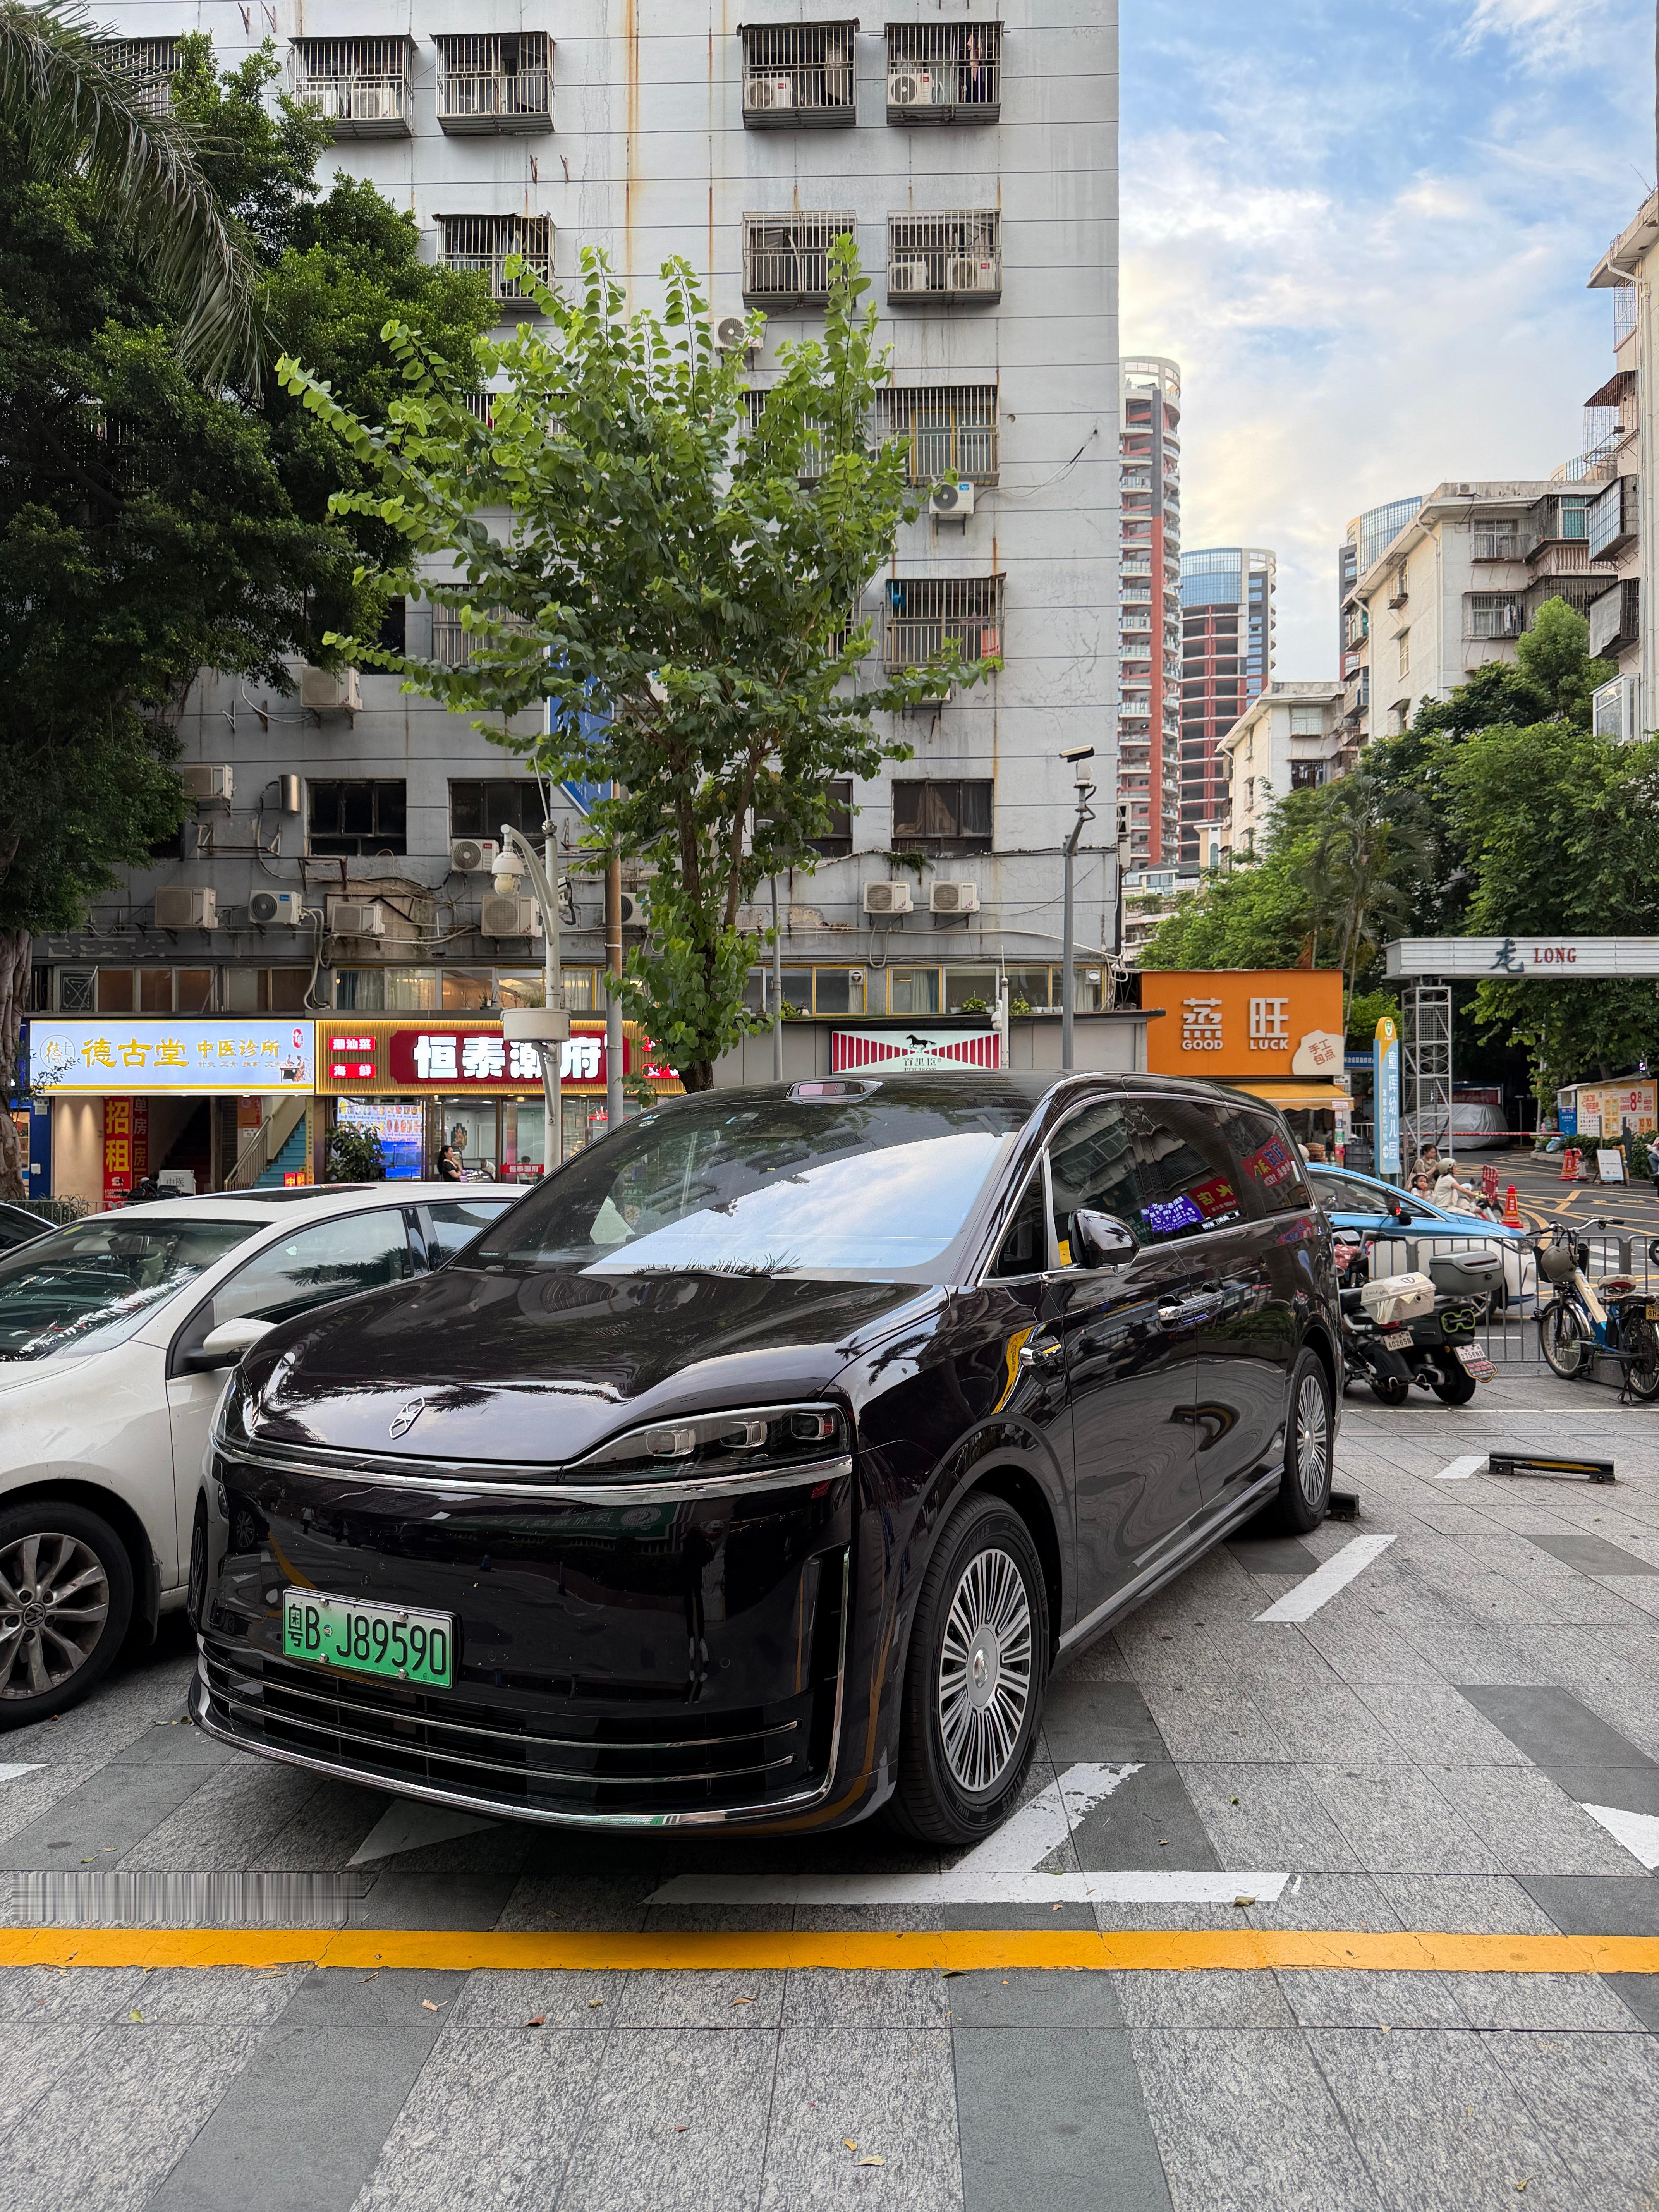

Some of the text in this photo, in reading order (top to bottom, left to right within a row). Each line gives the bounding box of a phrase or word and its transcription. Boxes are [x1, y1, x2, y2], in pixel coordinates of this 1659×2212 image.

[1534, 947, 1577, 963] LONG
[333, 1038, 371, 1049] 潮汕菜
[1182, 1039, 1289, 1050] GOOD LUCK
[1308, 1039, 1332, 1055] 手工
[81, 1037, 189, 1068] 德古堂
[197, 1038, 282, 1059] 中医诊所
[413, 1036, 601, 1079] 恒泰潮府
[1313, 1049, 1336, 1065] 包点
[334, 1065, 371, 1076] 海鲜
[106, 1101, 129, 1173] 招租
[166, 1177, 185, 1188] 中医
[1388, 1337, 1412, 1348] 40265N
[288, 1603, 447, 1675] 粤B J89590
